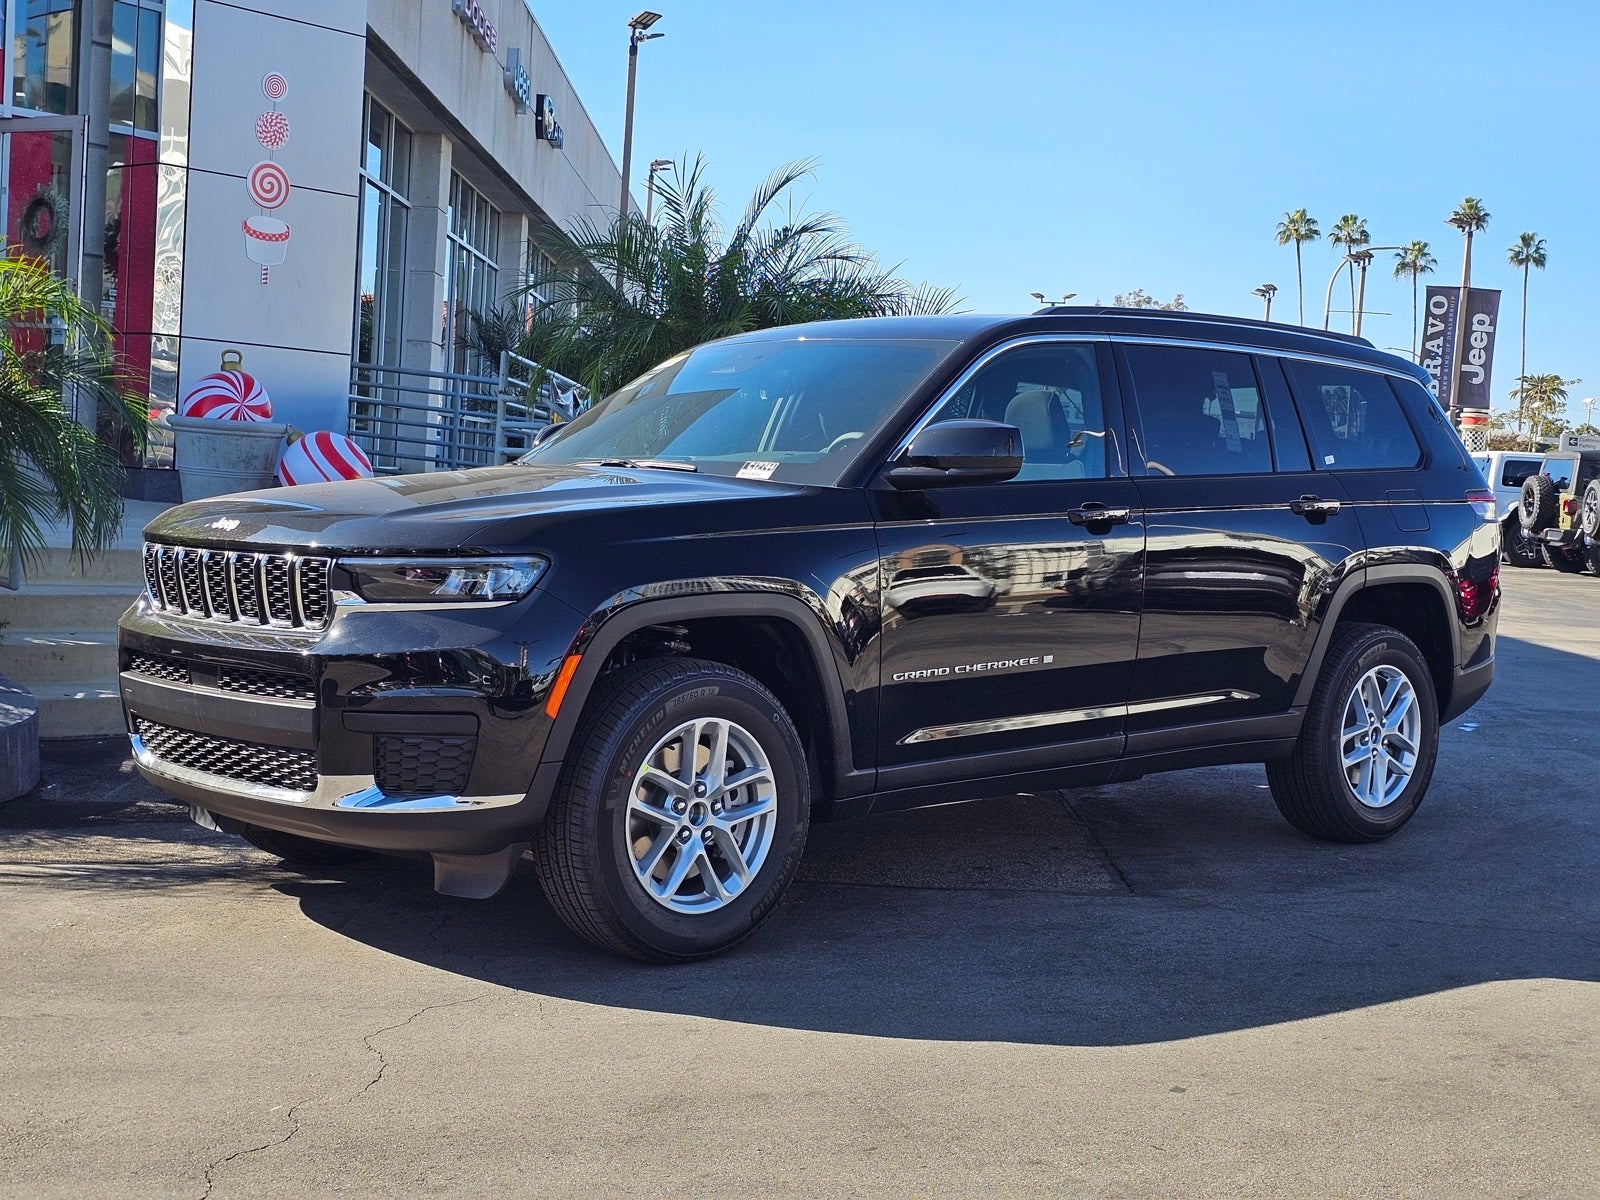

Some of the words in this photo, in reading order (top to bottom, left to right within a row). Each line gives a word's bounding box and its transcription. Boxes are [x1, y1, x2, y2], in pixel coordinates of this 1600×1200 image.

[1446, 295, 1456, 341] DEALERSHIP
[1445, 344, 1451, 353] OF
[1460, 313, 1494, 385] Jeep
[212, 517, 240, 532] Jeep
[892, 667, 950, 682] GRAND
[954, 656, 1040, 674] CHEROKEE
[700, 689, 706, 697] R
[619, 709, 665, 776] MICHELIN
